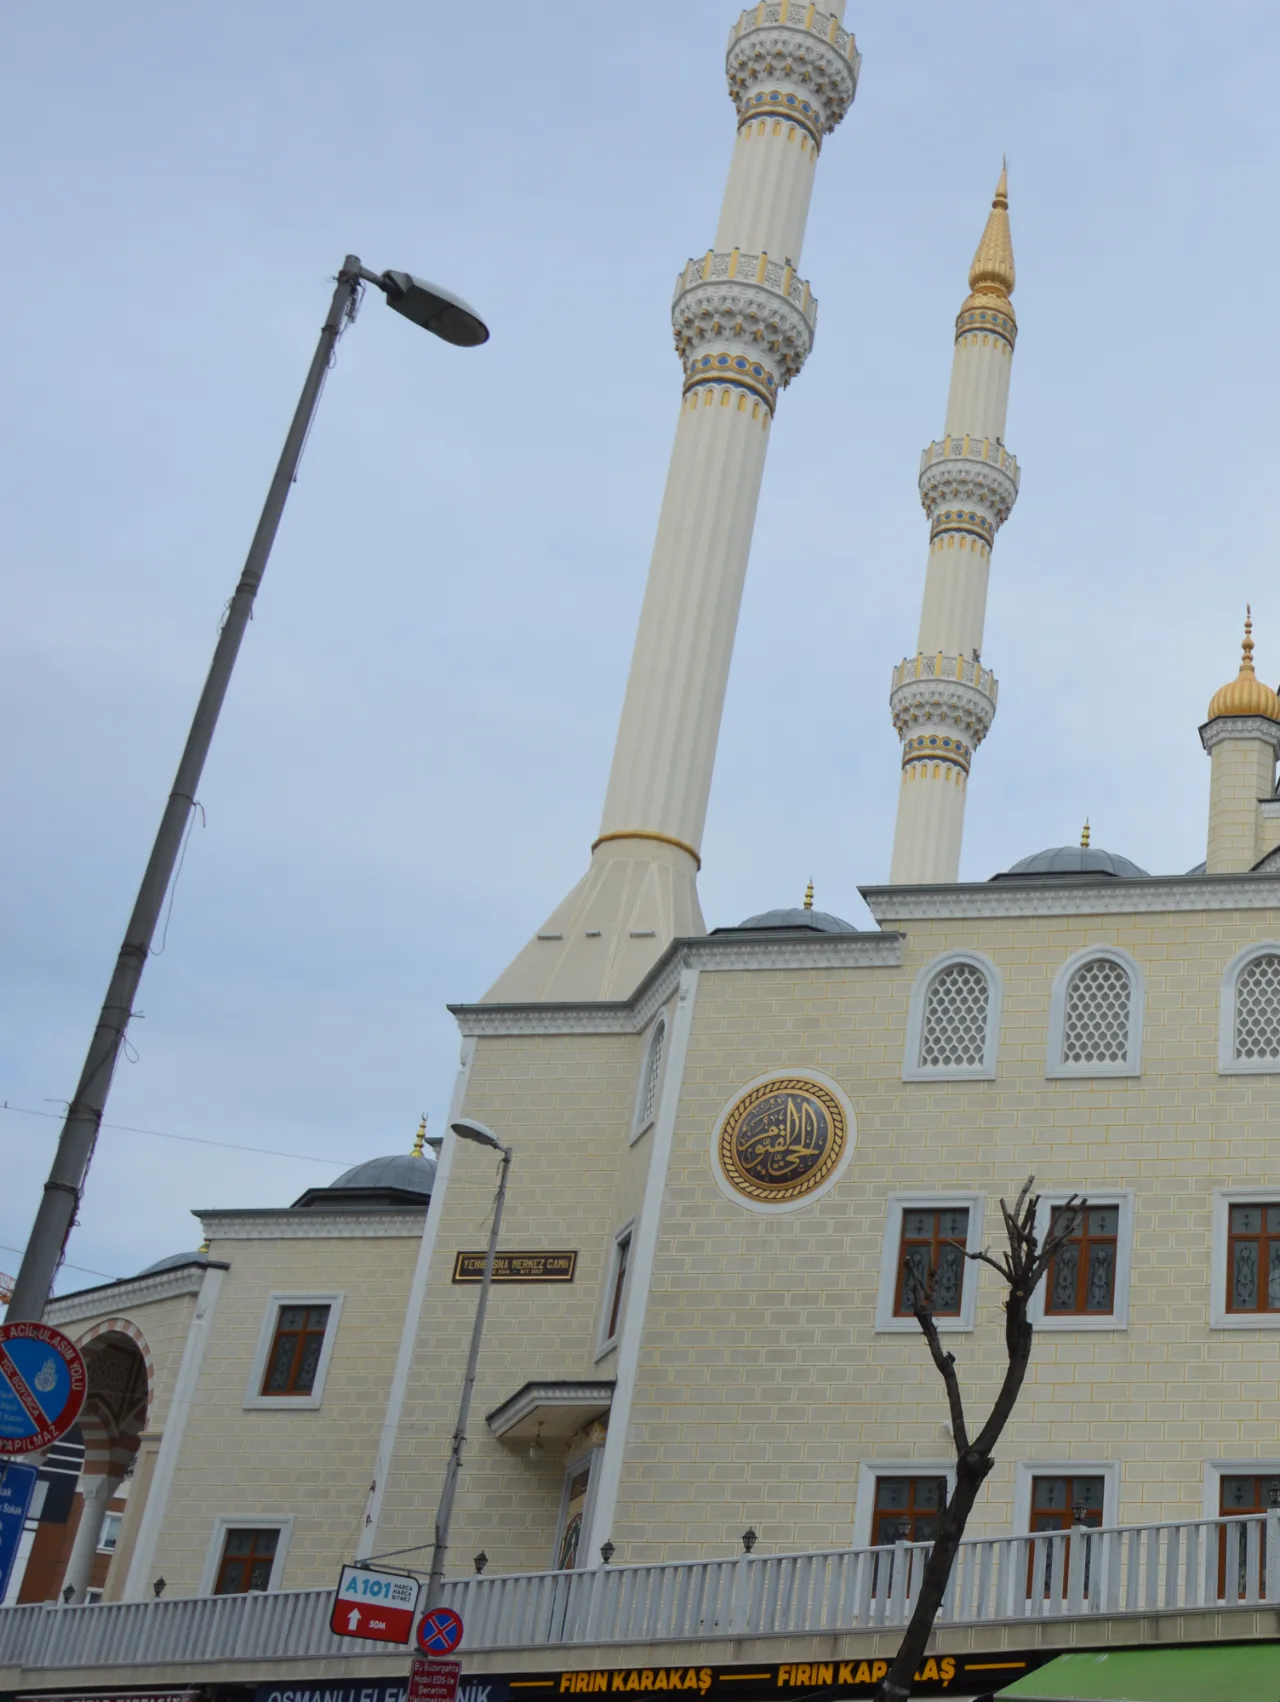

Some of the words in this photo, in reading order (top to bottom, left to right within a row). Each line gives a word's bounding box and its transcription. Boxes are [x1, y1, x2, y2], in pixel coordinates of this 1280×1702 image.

[512, 1259, 545, 1269] MERKEZ
[70, 1361, 83, 1391] YOLU
[414, 1662, 424, 1671] Bu
[777, 1663, 833, 1687] FIRIN
[838, 1657, 956, 1687] KARAŞ
[413, 1674, 432, 1684] Mobil
[432, 1675, 446, 1684] EDS
[560, 1671, 607, 1693] FIRIN
[611, 1668, 712, 1695] KARAKAŞ
[360, 1679, 494, 1702] ELEKNİK
[418, 1685, 448, 1695] Denetim
